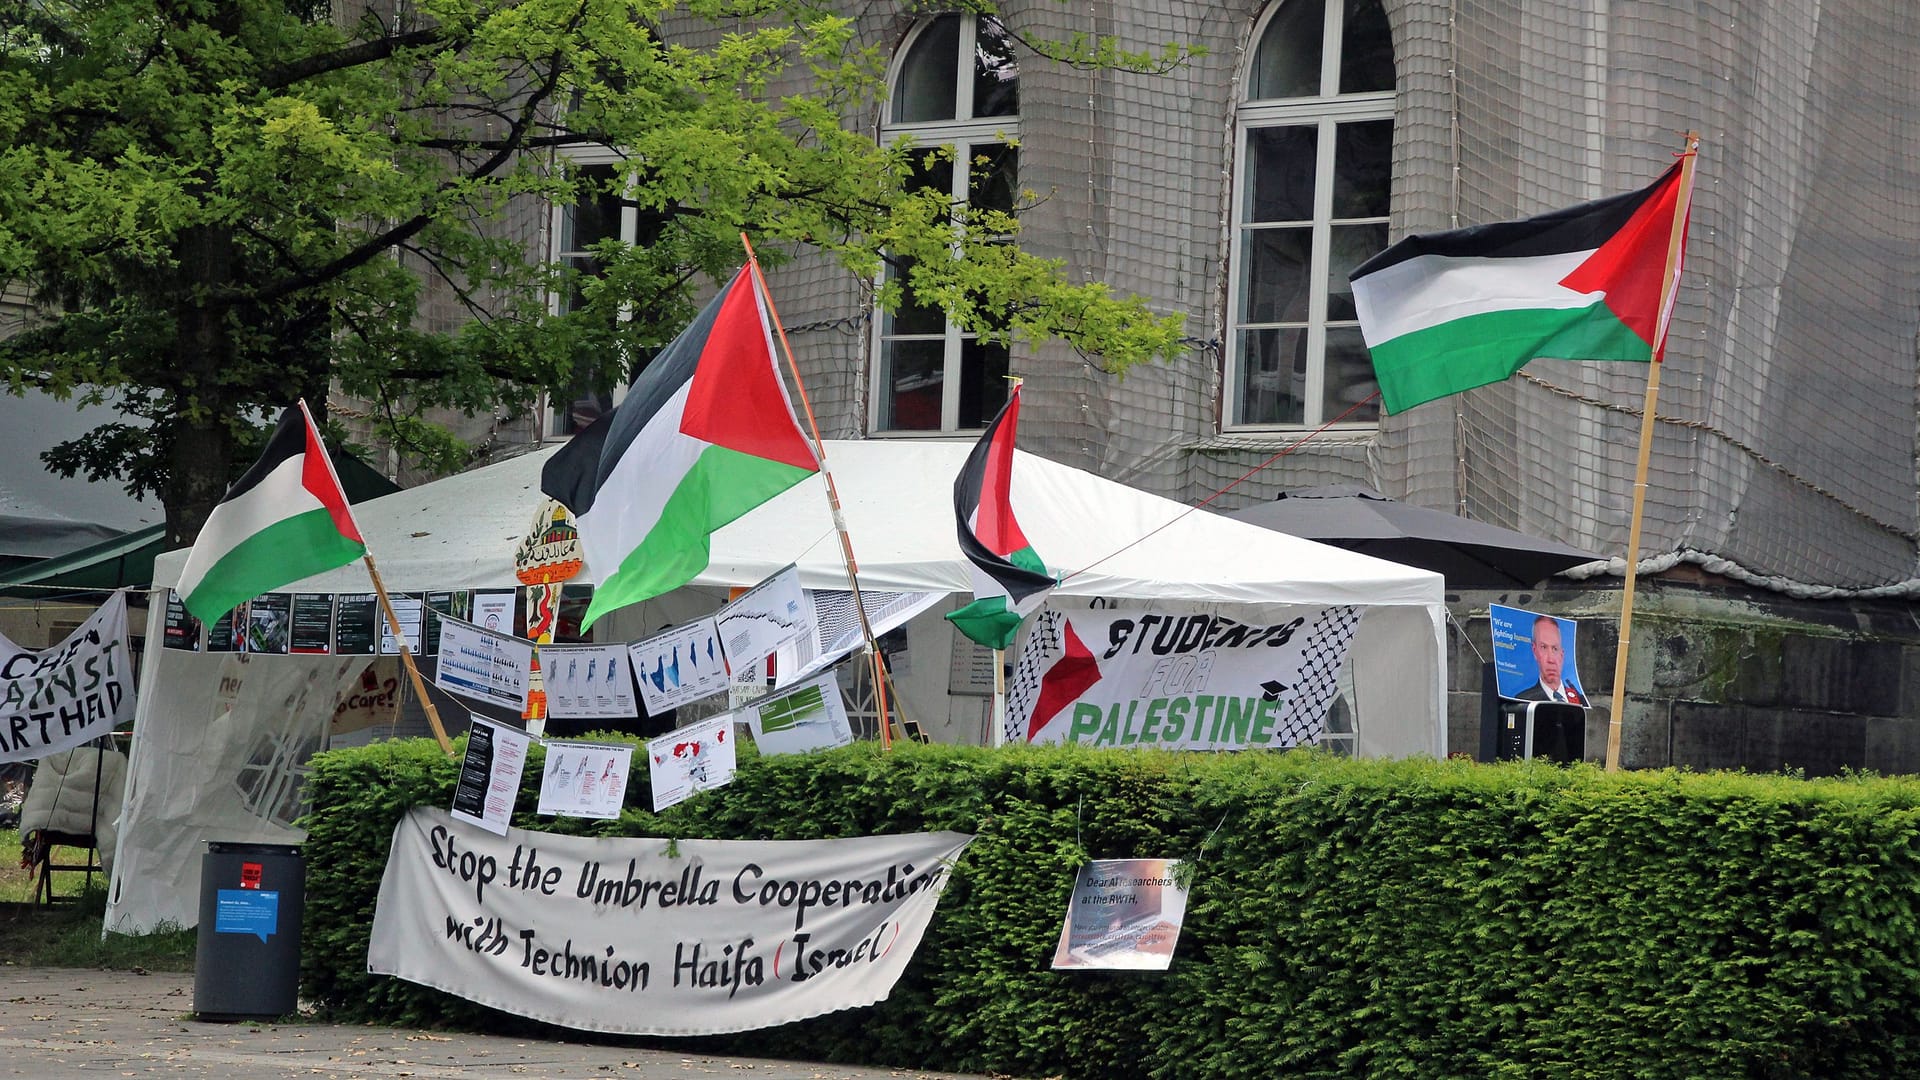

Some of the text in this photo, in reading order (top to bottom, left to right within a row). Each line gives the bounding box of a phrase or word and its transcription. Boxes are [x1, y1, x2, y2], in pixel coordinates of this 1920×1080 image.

[1103, 614, 1304, 659] STUDENTS
[1140, 650, 1217, 699] FOR
[1068, 695, 1283, 746] PALESTINE
[431, 825, 945, 929] Stop the Umbrella Cooperation
[1081, 894, 1138, 906] at the RWTH,
[1086, 876, 1172, 888] Dear AI researchers
[446, 914, 509, 957] with
[520, 928, 650, 993] Technion
[674, 938, 764, 1000] Haifa
